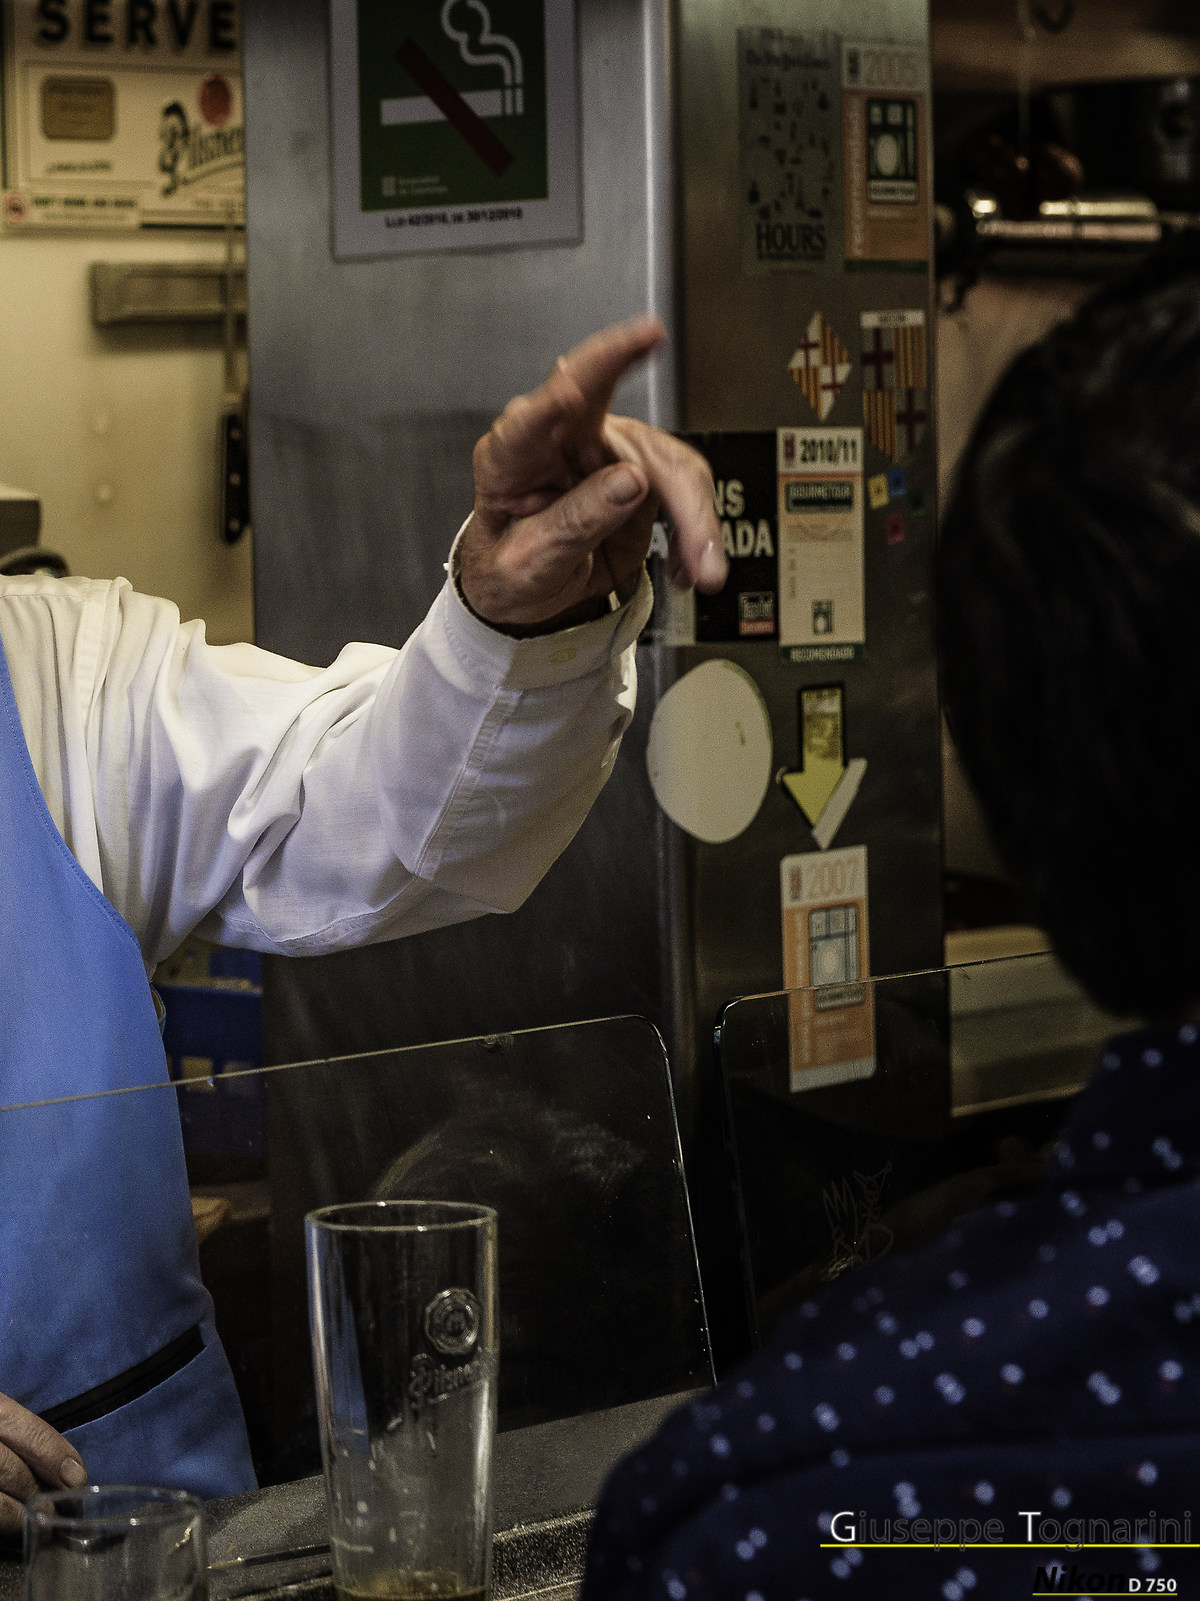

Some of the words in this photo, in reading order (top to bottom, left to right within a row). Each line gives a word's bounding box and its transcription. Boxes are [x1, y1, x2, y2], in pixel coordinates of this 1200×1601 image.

[864, 50, 919, 86] 2005
[755, 222, 826, 251] HOURS
[800, 436, 858, 465] 2010/11
[808, 856, 859, 899] 2007
